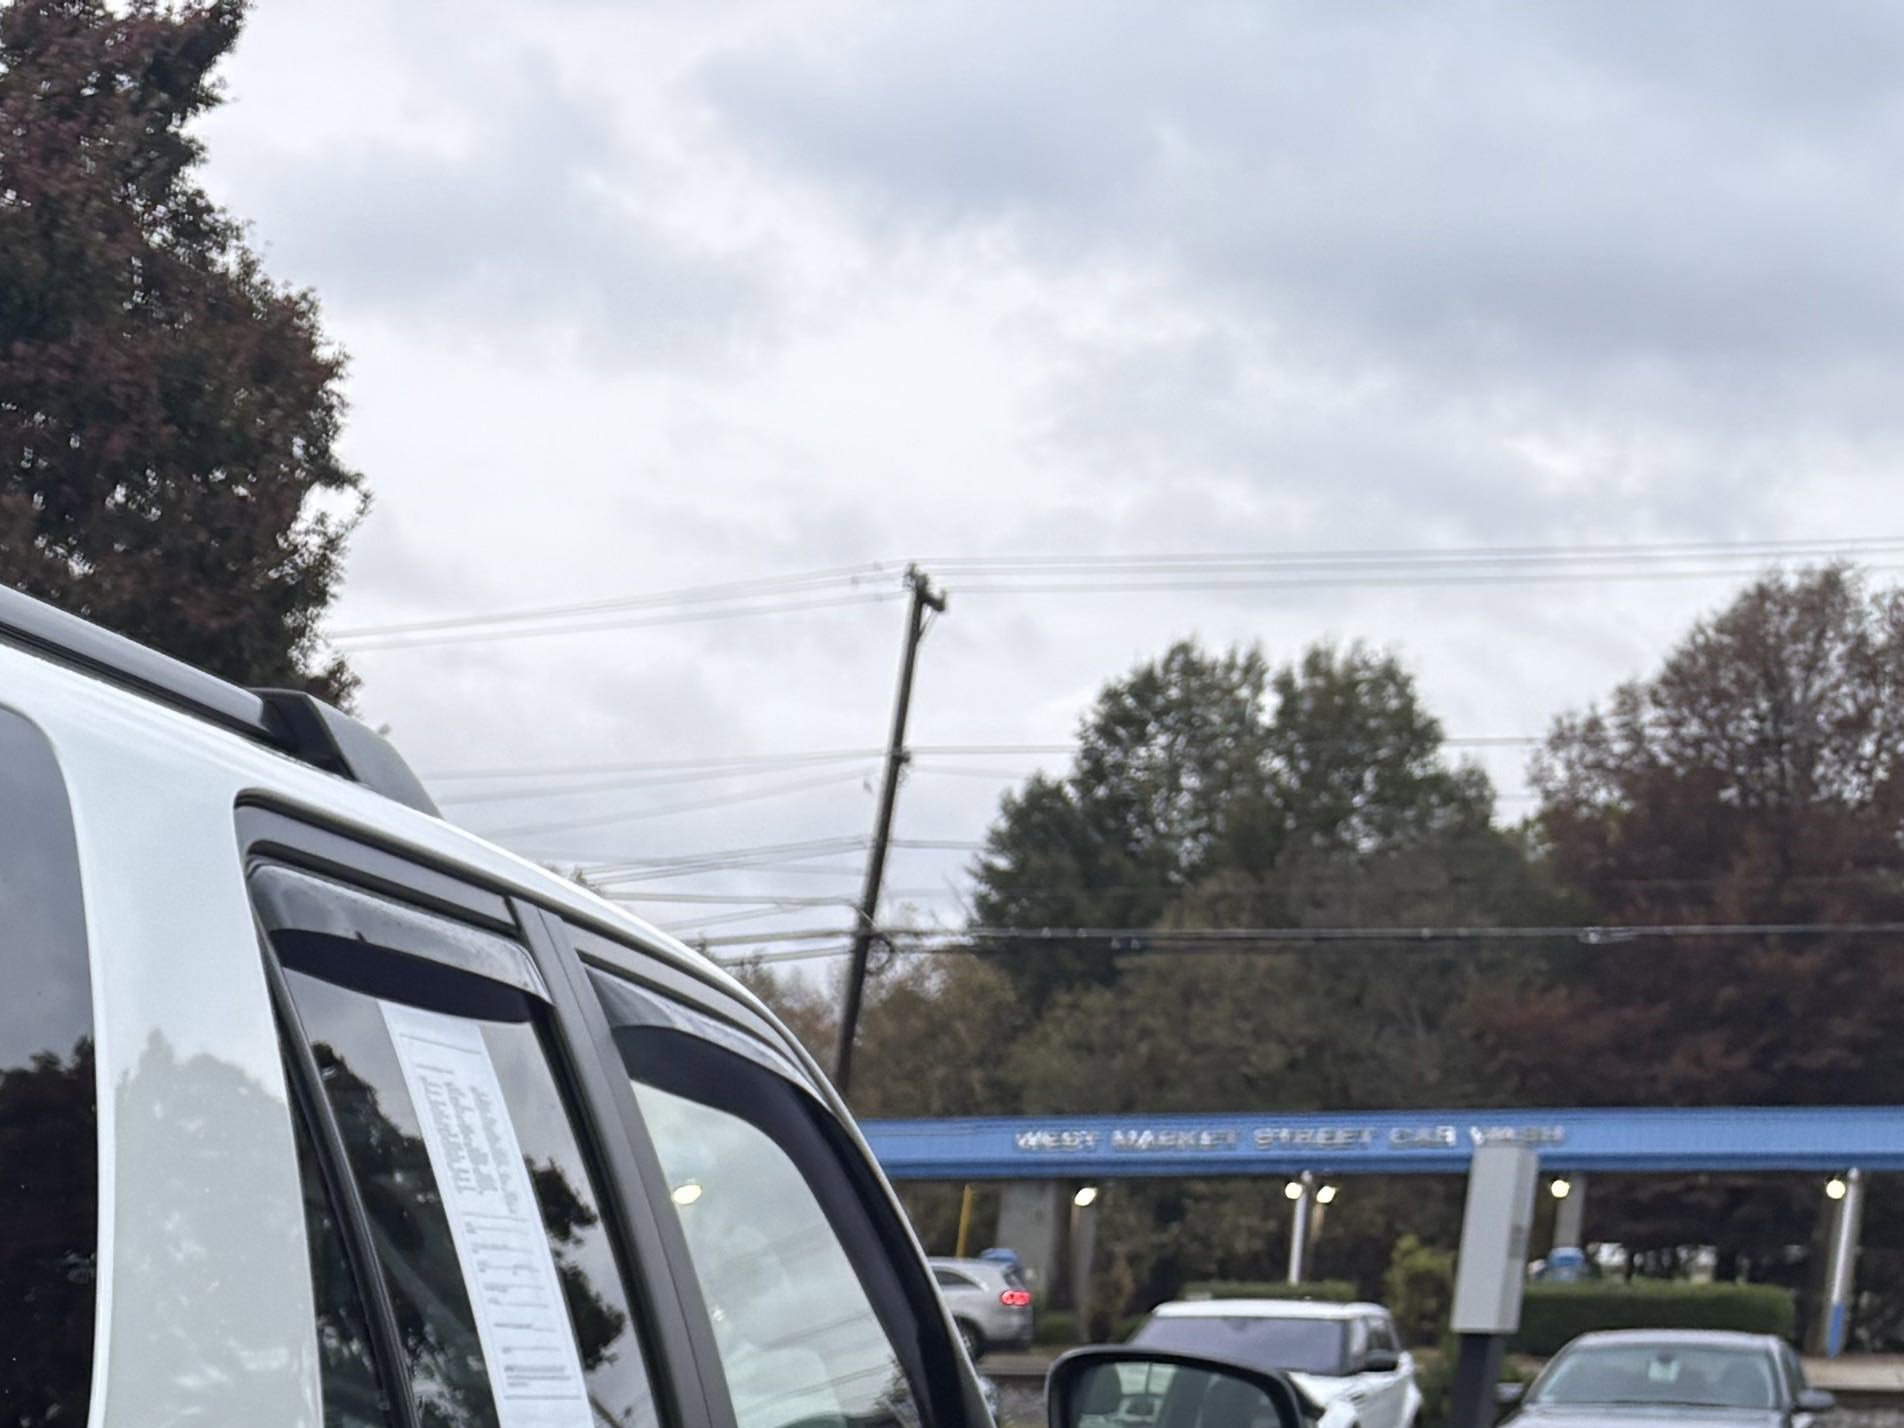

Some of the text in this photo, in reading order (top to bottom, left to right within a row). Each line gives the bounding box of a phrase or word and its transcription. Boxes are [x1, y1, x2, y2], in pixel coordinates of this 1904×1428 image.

[1015, 1128, 1099, 1150] WEST
[1110, 1128, 1239, 1150] MARKET
[1252, 1126, 1376, 1149] STREET
[1389, 1125, 1457, 1147] CAR
